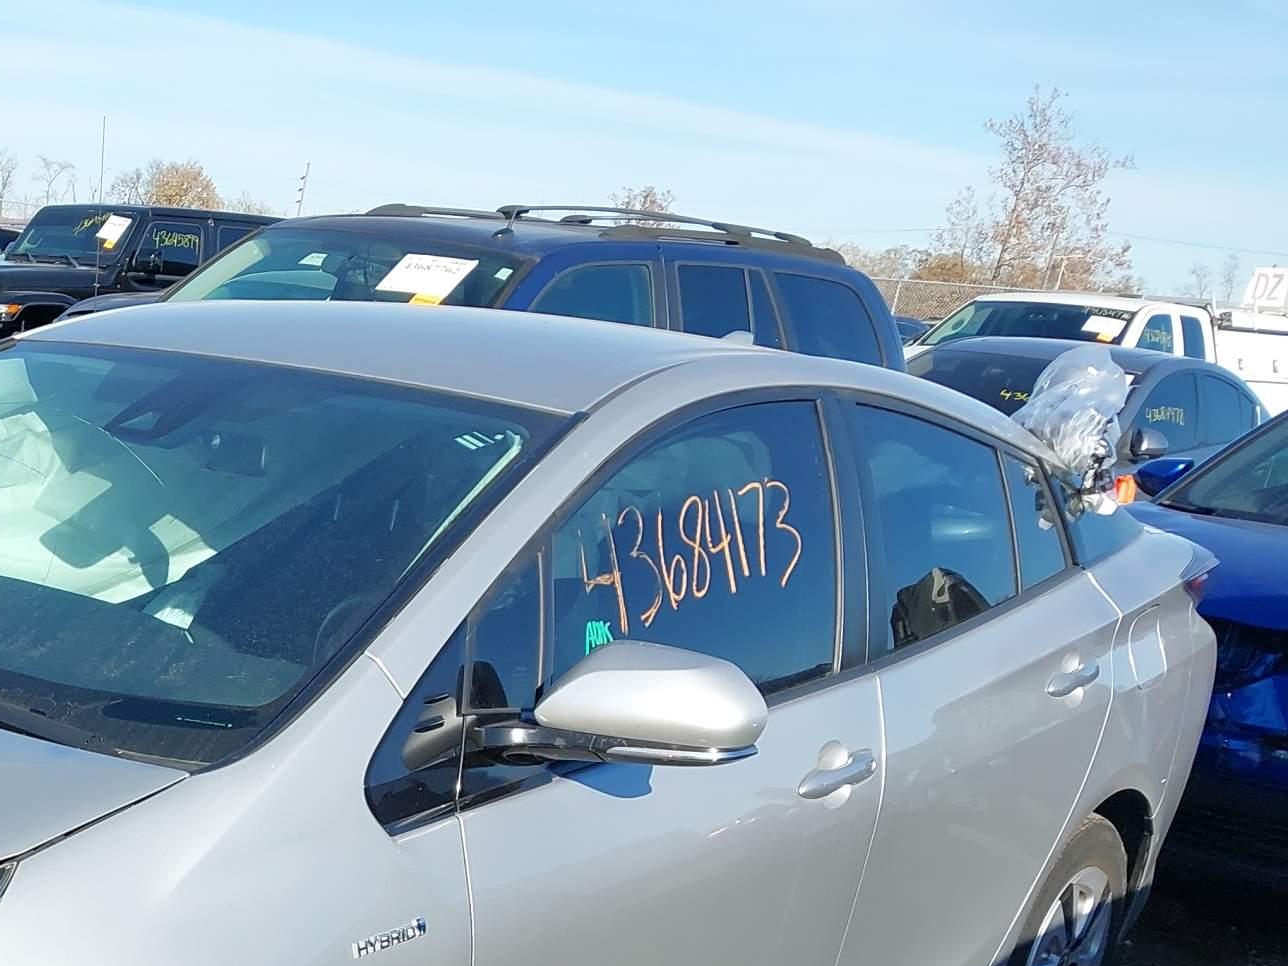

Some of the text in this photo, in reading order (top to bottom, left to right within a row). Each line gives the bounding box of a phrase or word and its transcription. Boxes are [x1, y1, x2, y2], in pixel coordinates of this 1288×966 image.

[152, 227, 200, 256] 43645899
[577, 477, 803, 636] 43684173
[352, 926, 416, 958] HYBRID
